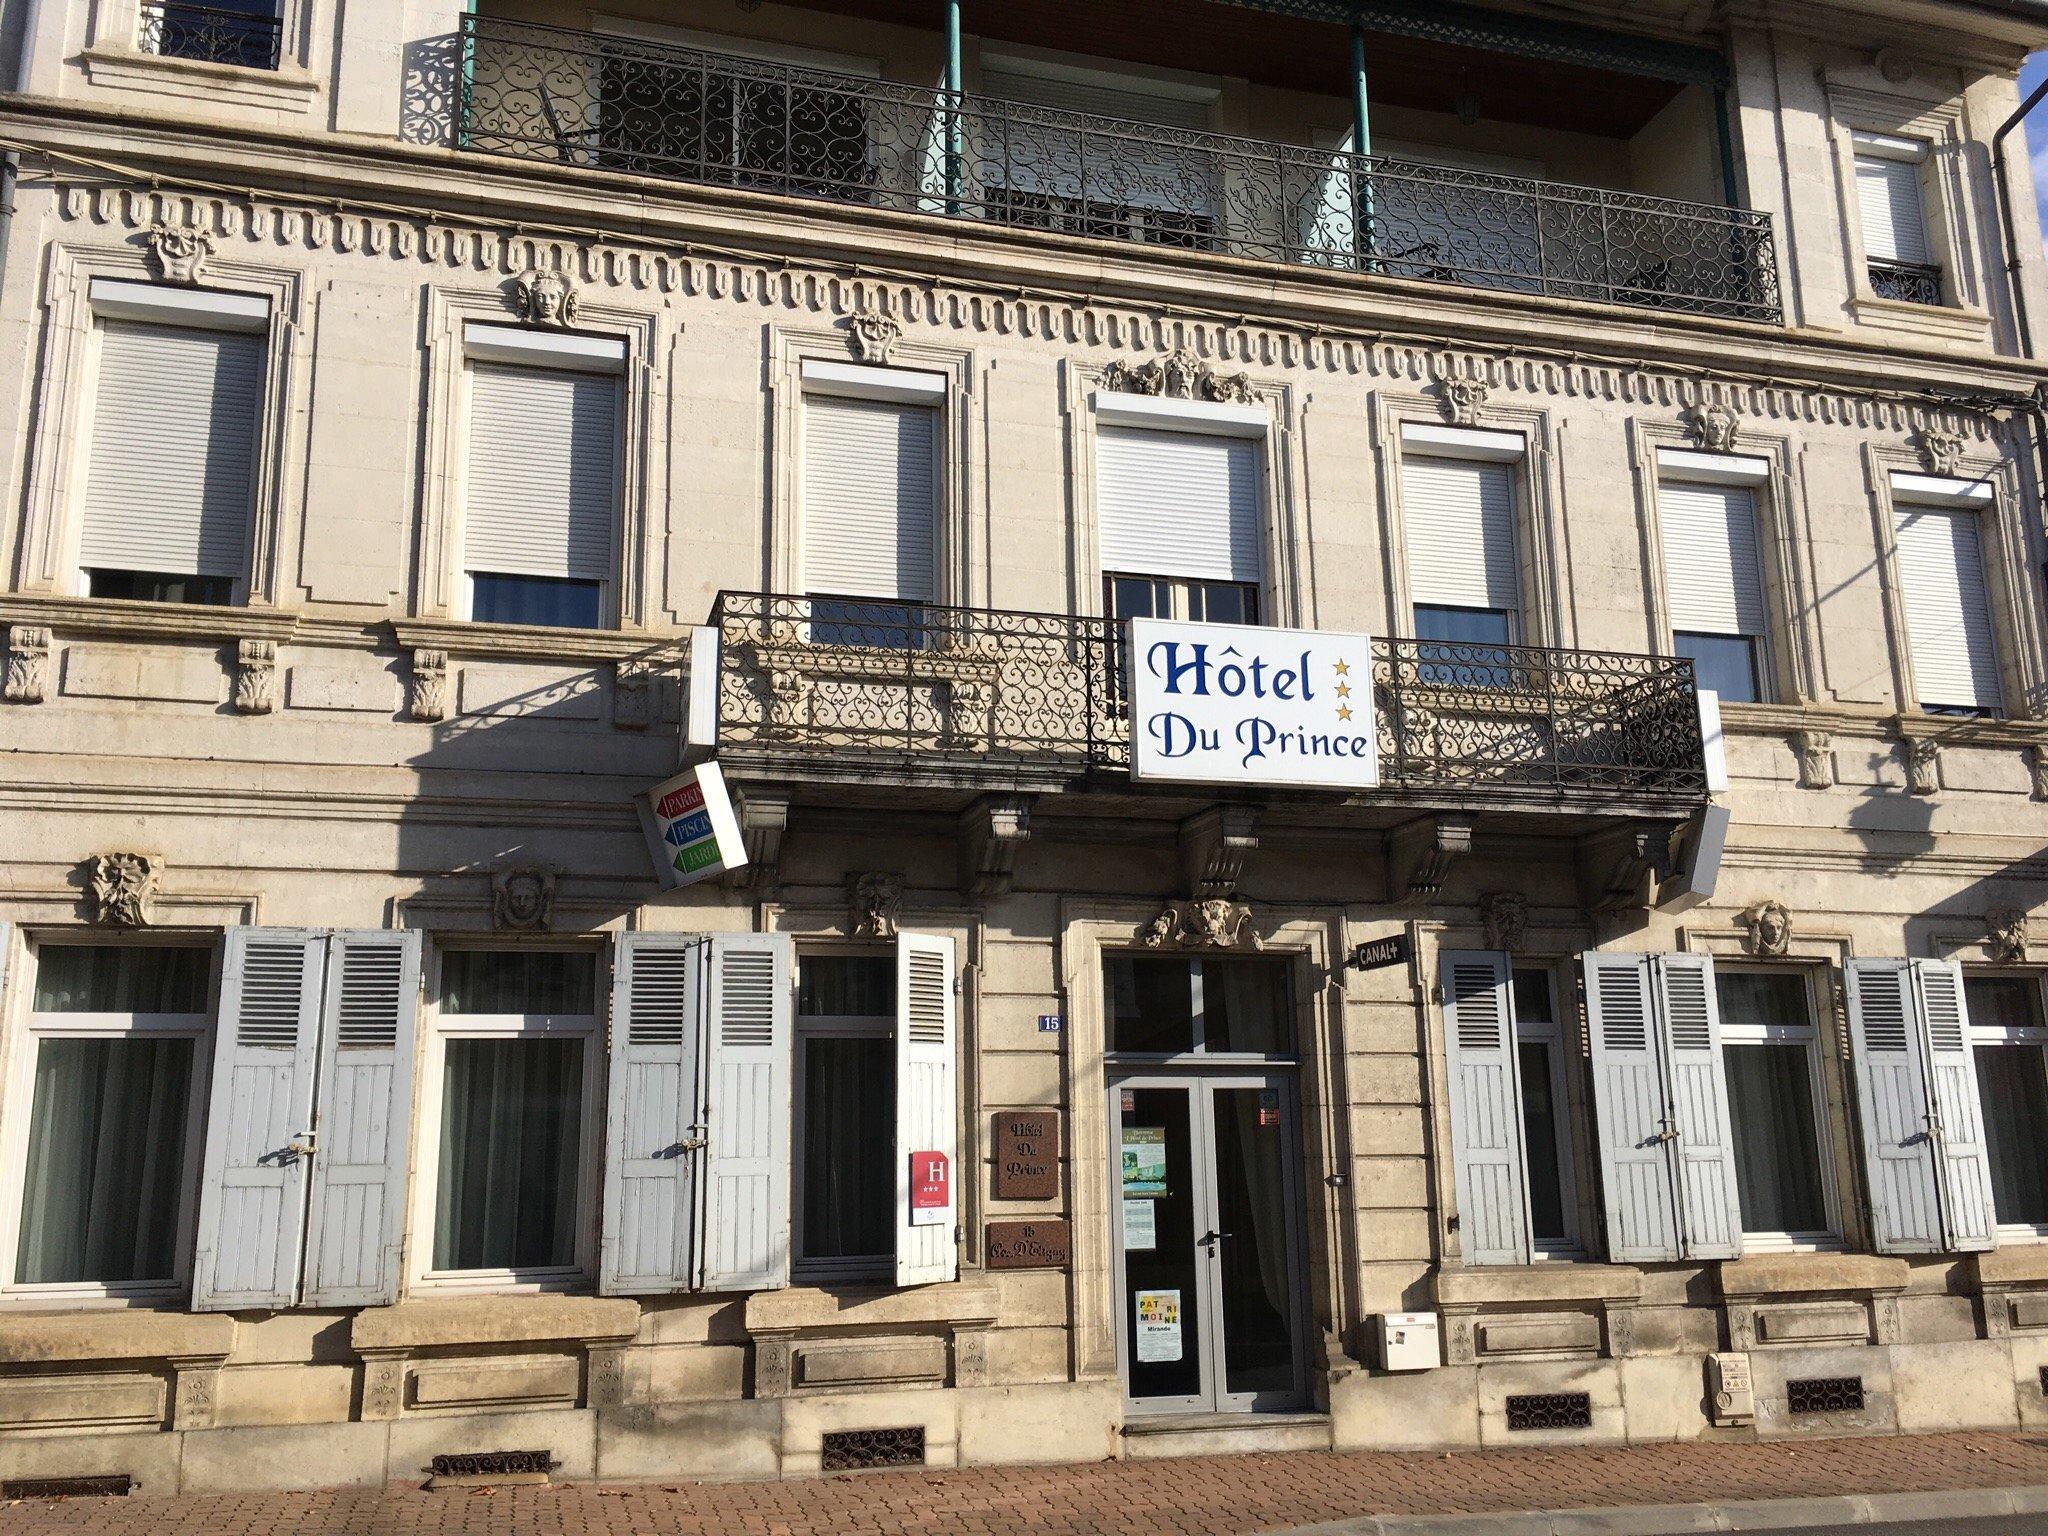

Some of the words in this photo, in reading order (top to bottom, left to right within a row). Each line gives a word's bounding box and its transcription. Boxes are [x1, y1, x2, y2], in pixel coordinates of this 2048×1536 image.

[1147, 641, 1315, 701] Hôtel
[1148, 711, 1221, 758] Du
[1235, 717, 1367, 769] Prince
[1360, 942, 1398, 965] CANAL+
[1044, 1017, 1059, 1030] 15
[929, 1161, 945, 1182] H
[1140, 1313, 1163, 1322] MOI
[1165, 1316, 1177, 1324] NE
